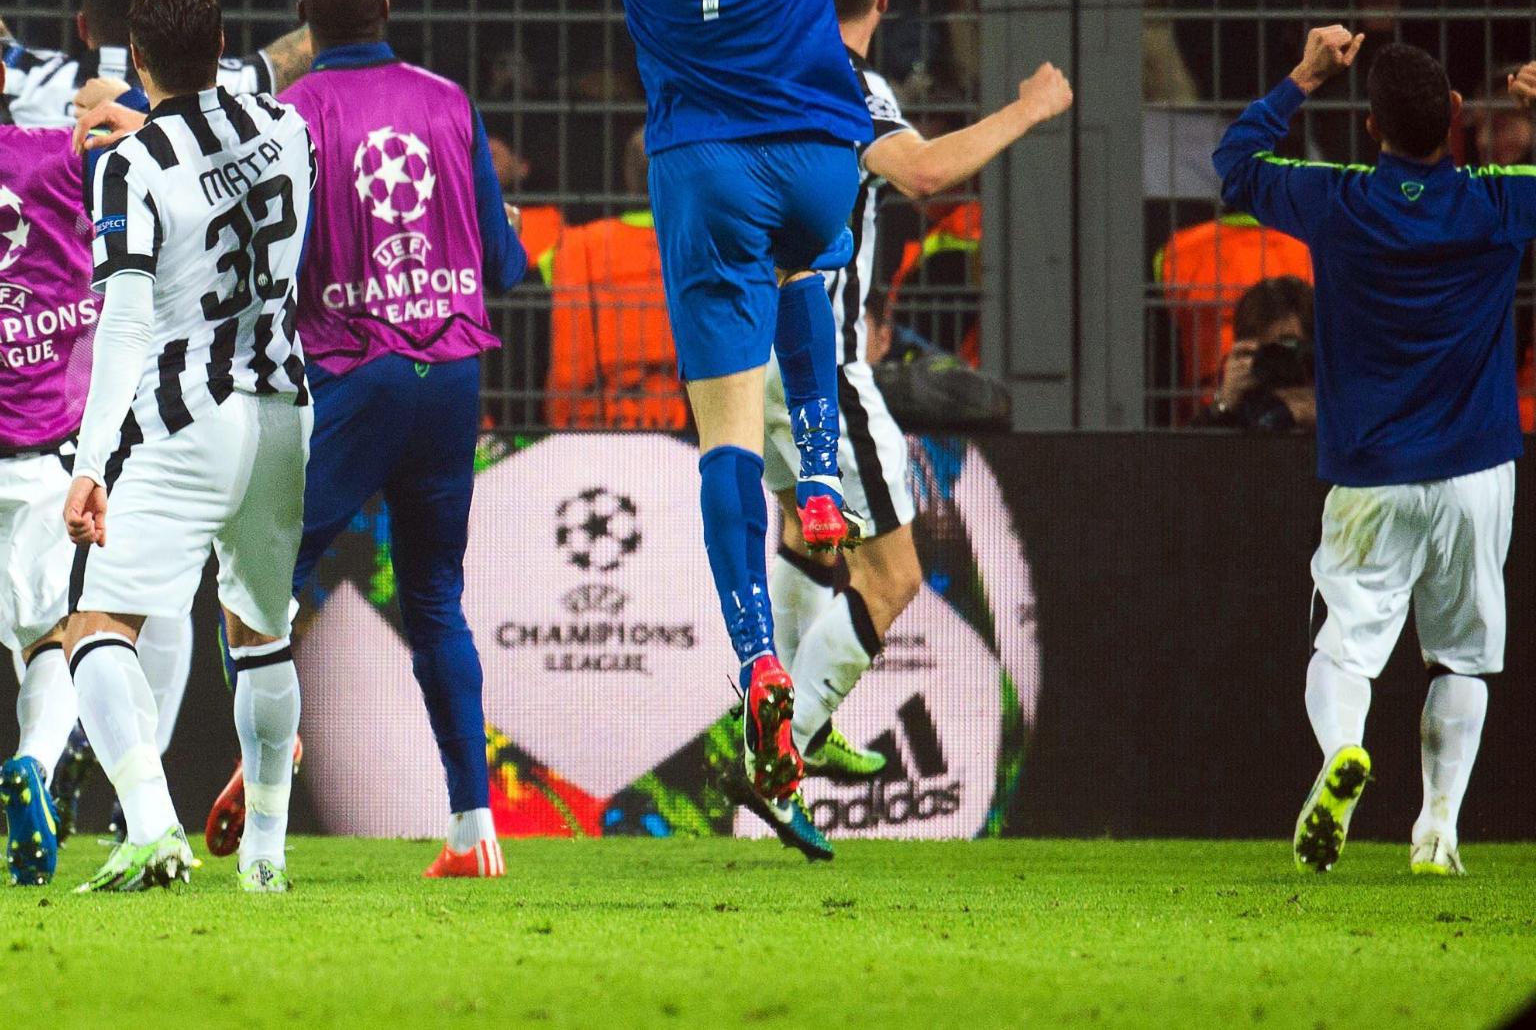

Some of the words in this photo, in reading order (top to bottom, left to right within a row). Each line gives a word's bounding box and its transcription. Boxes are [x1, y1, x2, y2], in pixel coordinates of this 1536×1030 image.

[199, 173, 298, 321] 32
[495, 620, 696, 649] CHAMPIONS
[543, 652, 650, 676] LEAGUE
[812, 777, 961, 832] adidas
